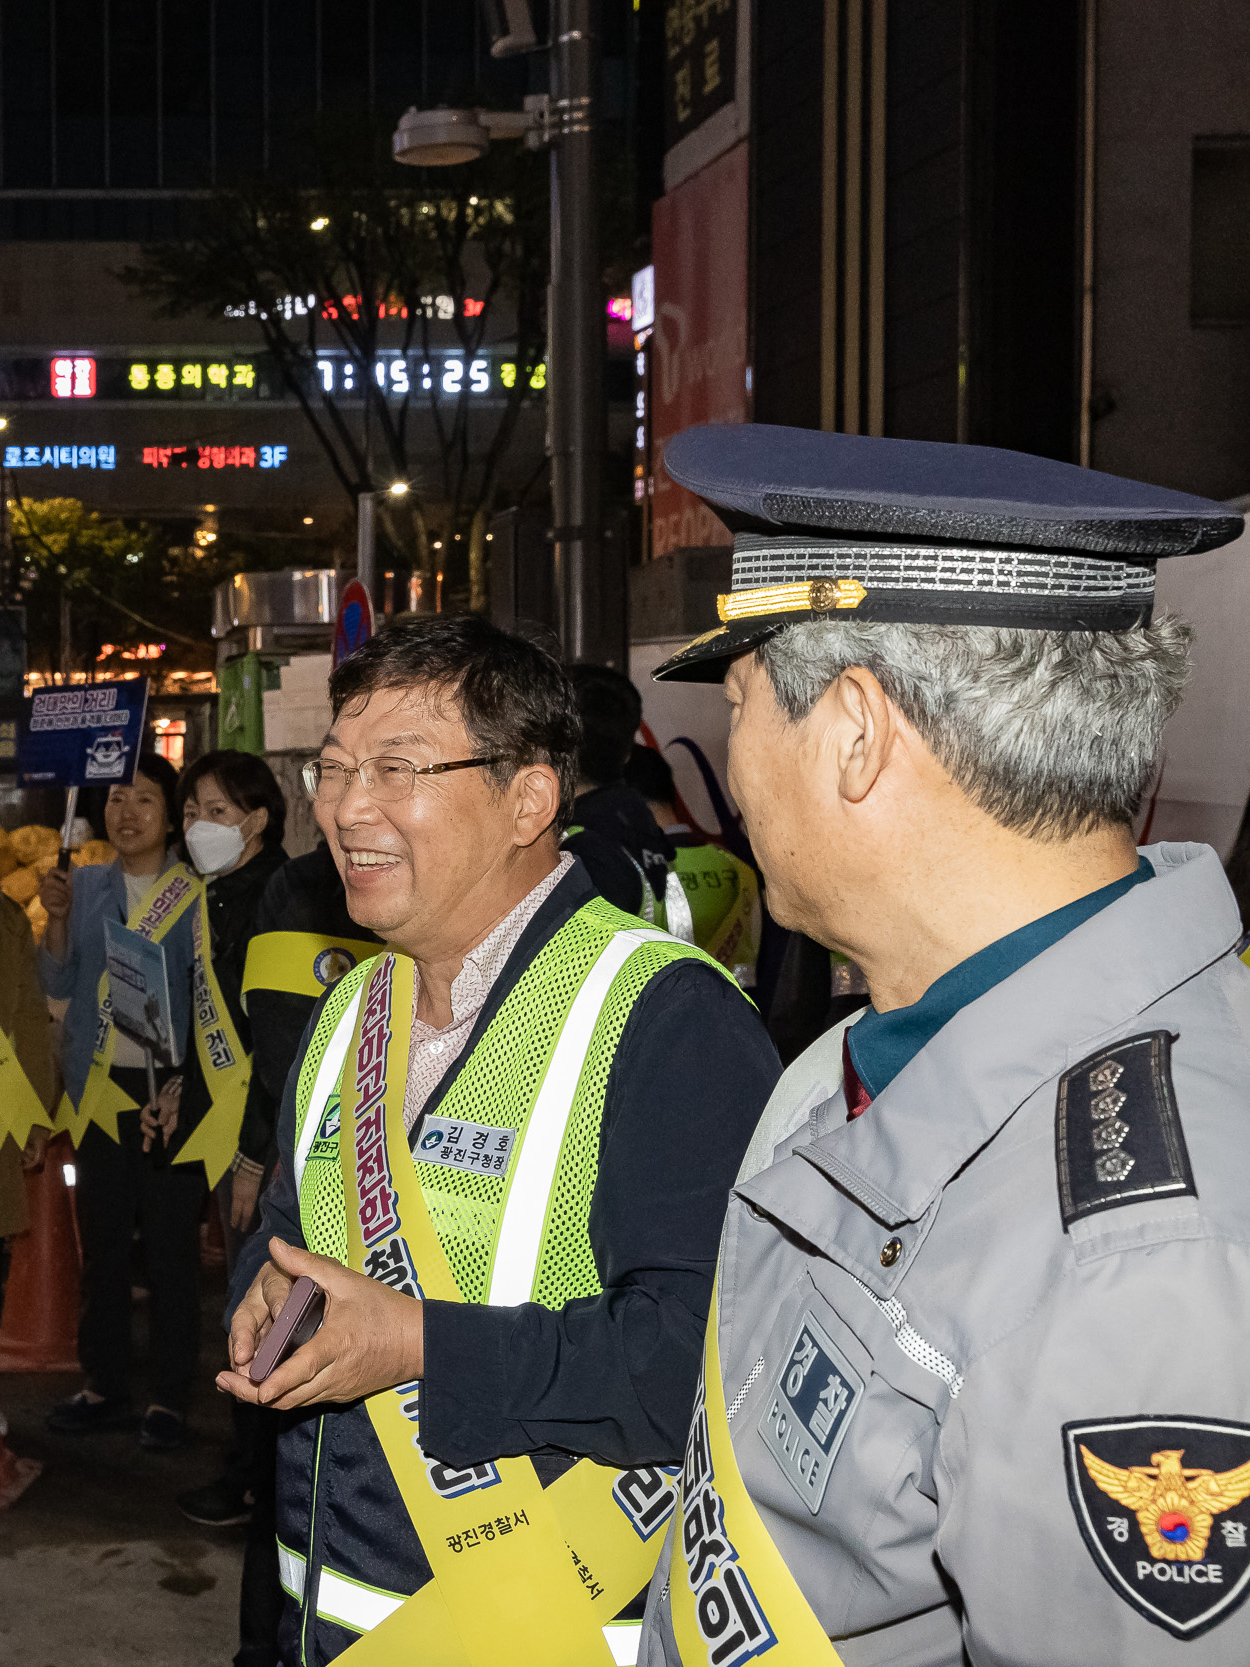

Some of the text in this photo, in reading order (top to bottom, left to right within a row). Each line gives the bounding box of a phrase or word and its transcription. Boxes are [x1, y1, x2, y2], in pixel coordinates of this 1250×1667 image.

[3, 445, 116, 470] 로즈시티의원
[259, 445, 288, 469] 3F
[206, 1028, 236, 1071] 거리
[353, 951, 396, 1120] 안전하고
[355, 1103, 402, 1247] 건전한
[440, 1145, 505, 1170] 광진구청장
[768, 1398, 821, 1490] POLICE
[445, 1508, 531, 1555] 광진경찰서
[1136, 1560, 1224, 1584] POLICE
